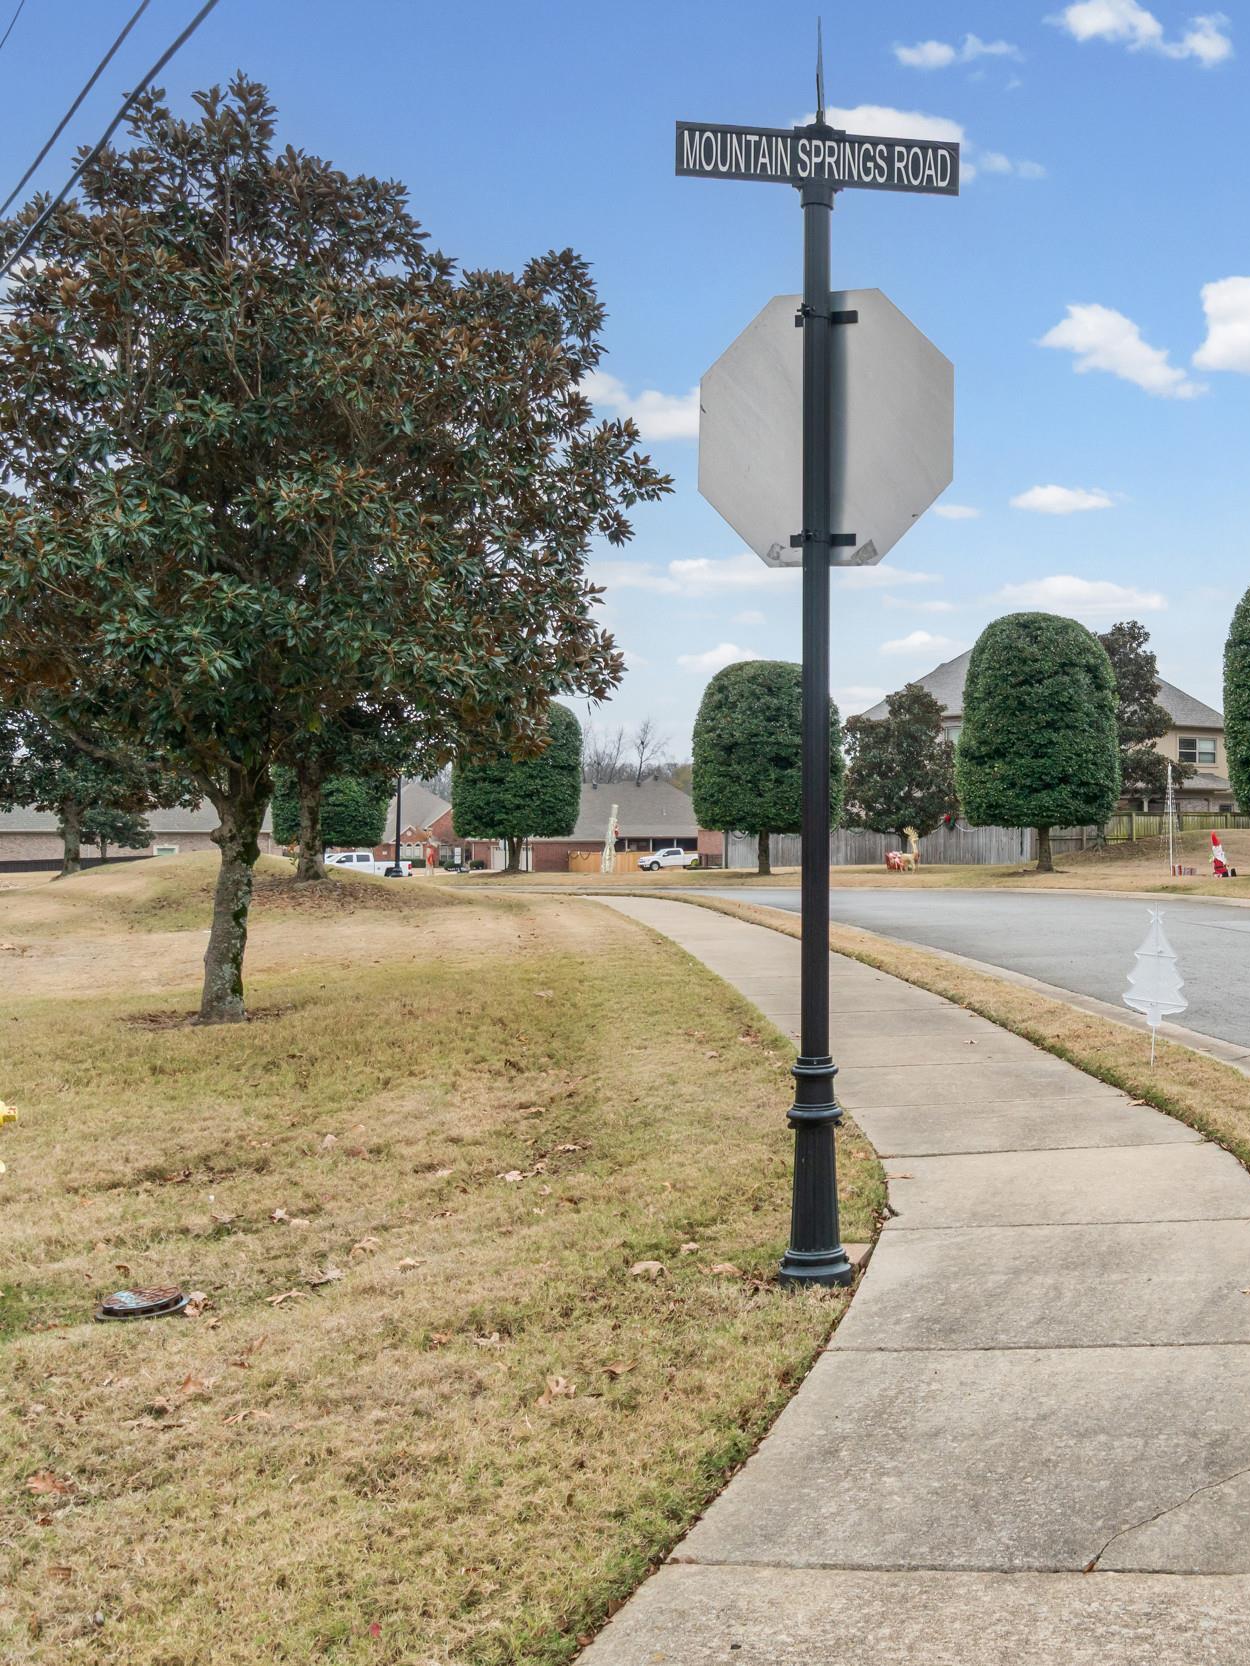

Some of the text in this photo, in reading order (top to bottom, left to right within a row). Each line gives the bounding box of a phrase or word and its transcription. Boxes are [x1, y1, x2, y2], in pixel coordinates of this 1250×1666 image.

[683, 129, 951, 187] MOUNTAIN SPRINGS ROAD
